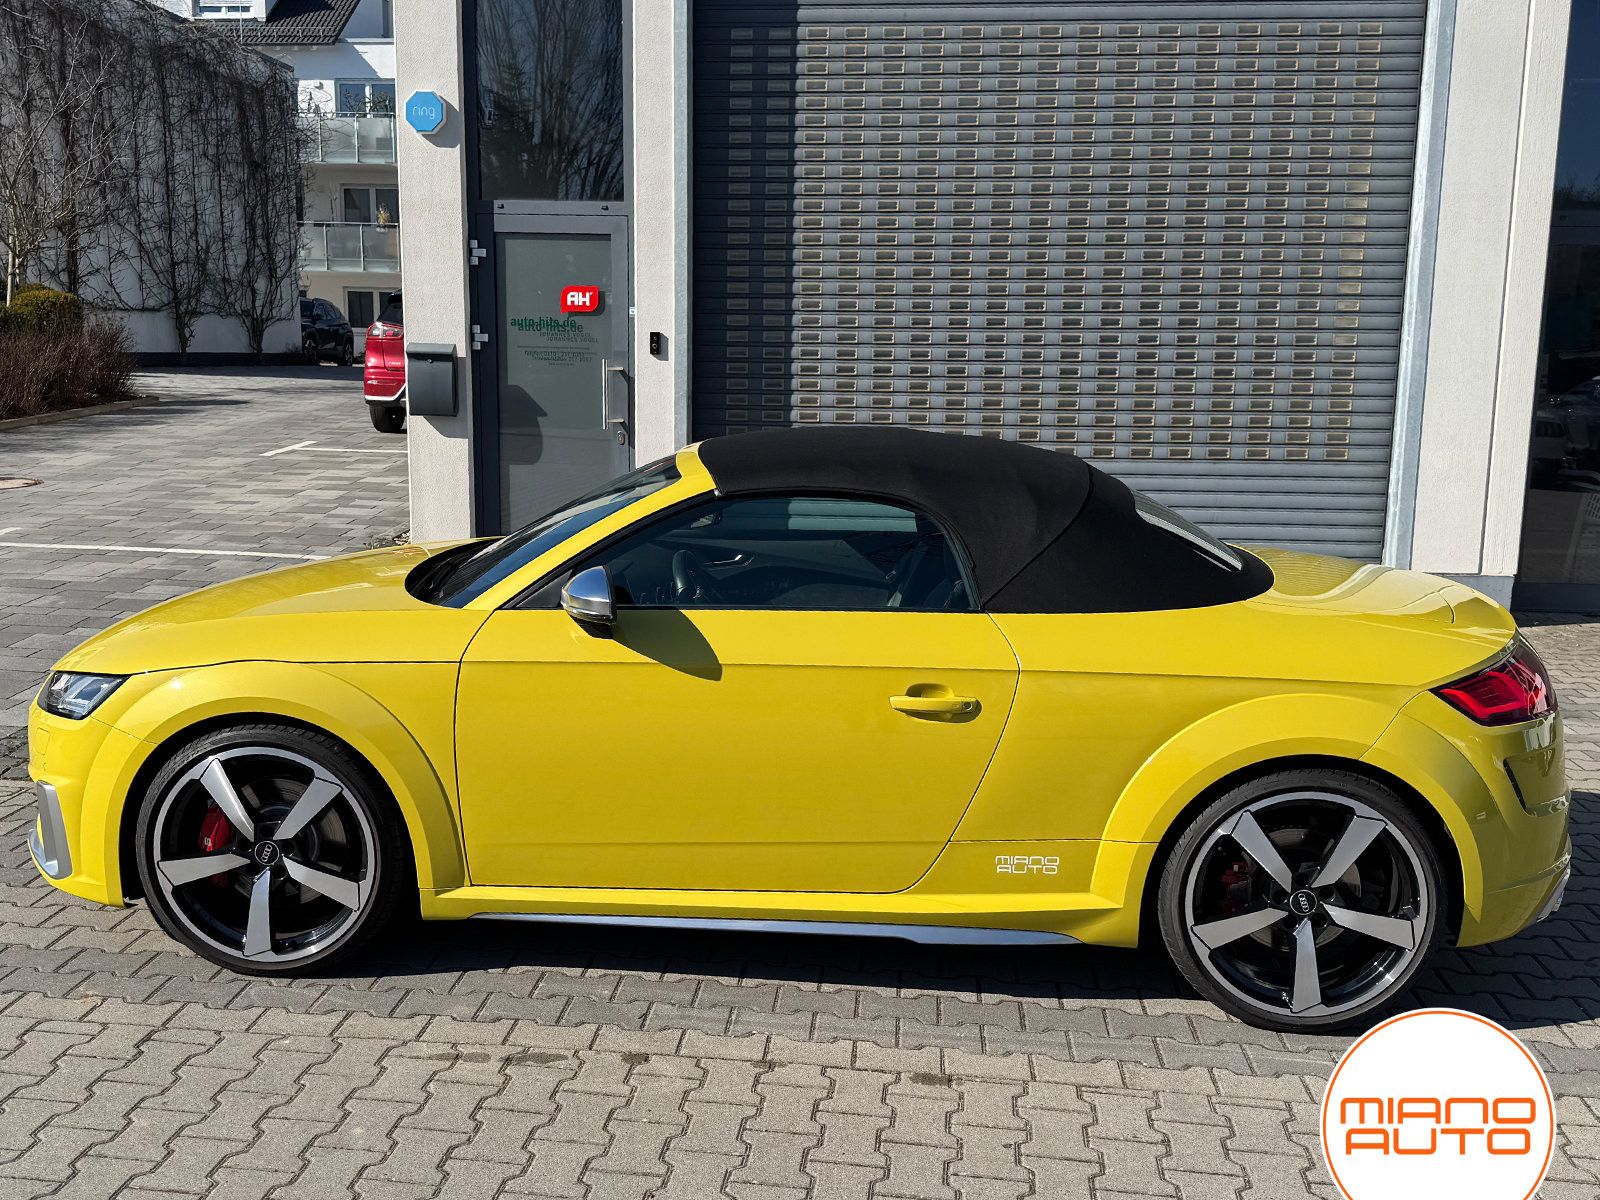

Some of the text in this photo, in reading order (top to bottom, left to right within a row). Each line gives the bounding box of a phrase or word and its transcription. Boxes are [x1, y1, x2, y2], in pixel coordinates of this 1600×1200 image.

[413, 104, 435, 120] ring
[995, 856, 1060, 865] MIANO
[996, 865, 1058, 874] AUTO
